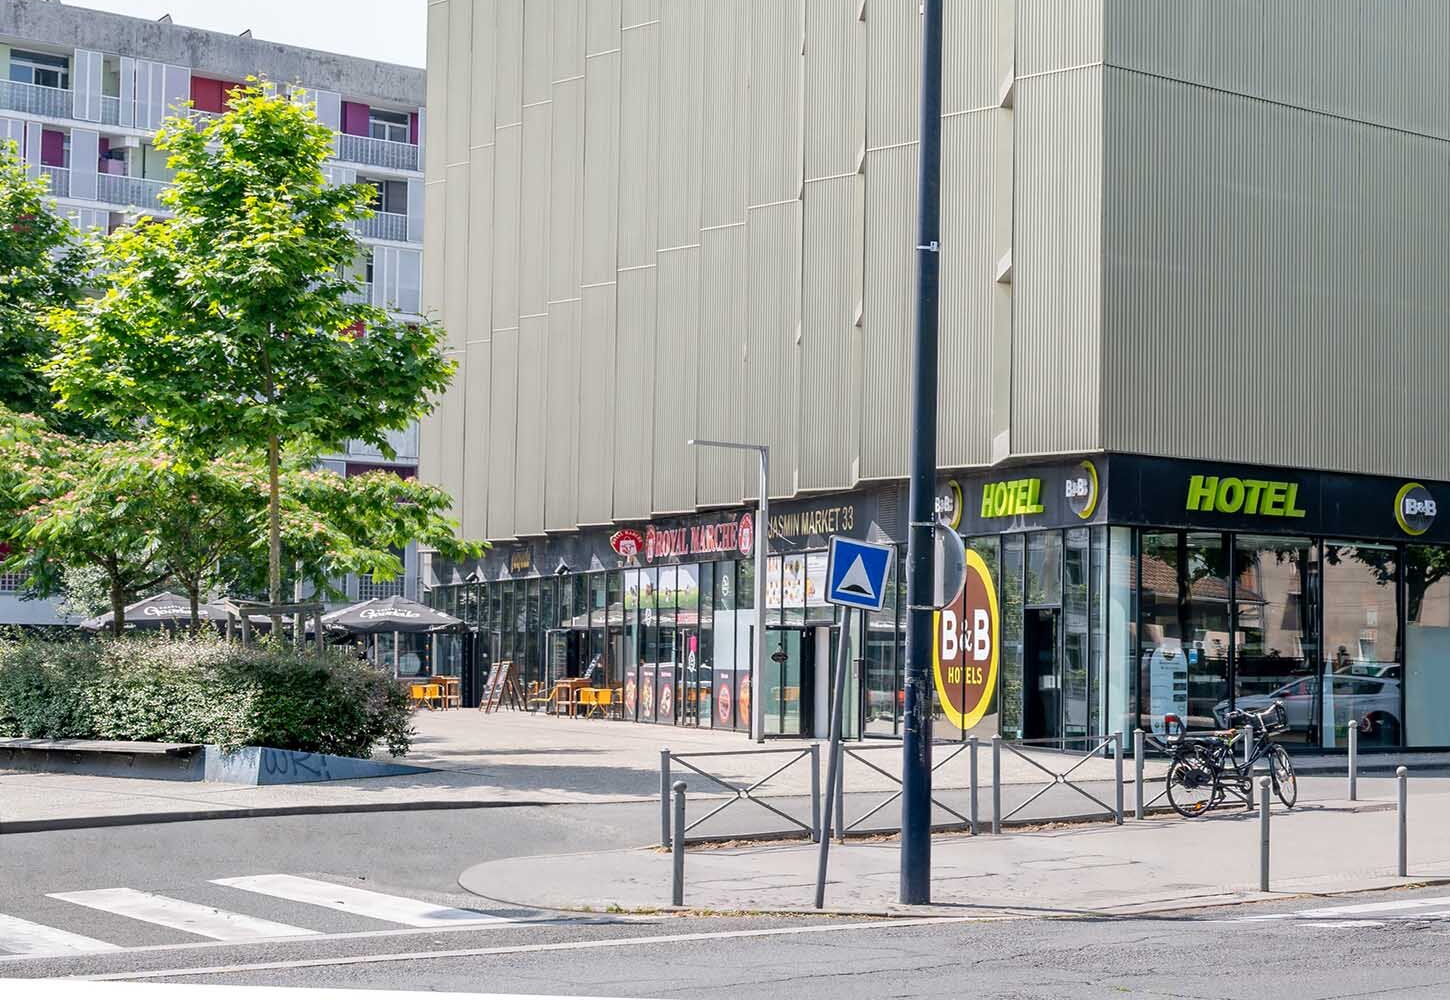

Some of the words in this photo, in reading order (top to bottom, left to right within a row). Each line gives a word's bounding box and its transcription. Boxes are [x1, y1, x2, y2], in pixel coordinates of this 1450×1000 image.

[981, 478, 1045, 519] HOTEL
[1186, 475, 1306, 517] HOTEL
[1405, 498, 1437, 516] B&B
[655, 529, 689, 558] ROYAL
[690, 513, 738, 554] MARCHÉ
[769, 513, 800, 539] JASMIN
[801, 507, 841, 535] MARKET
[842, 505, 854, 530] 33
[942, 609, 990, 660] B&B
[948, 666, 983, 684] HOELS
